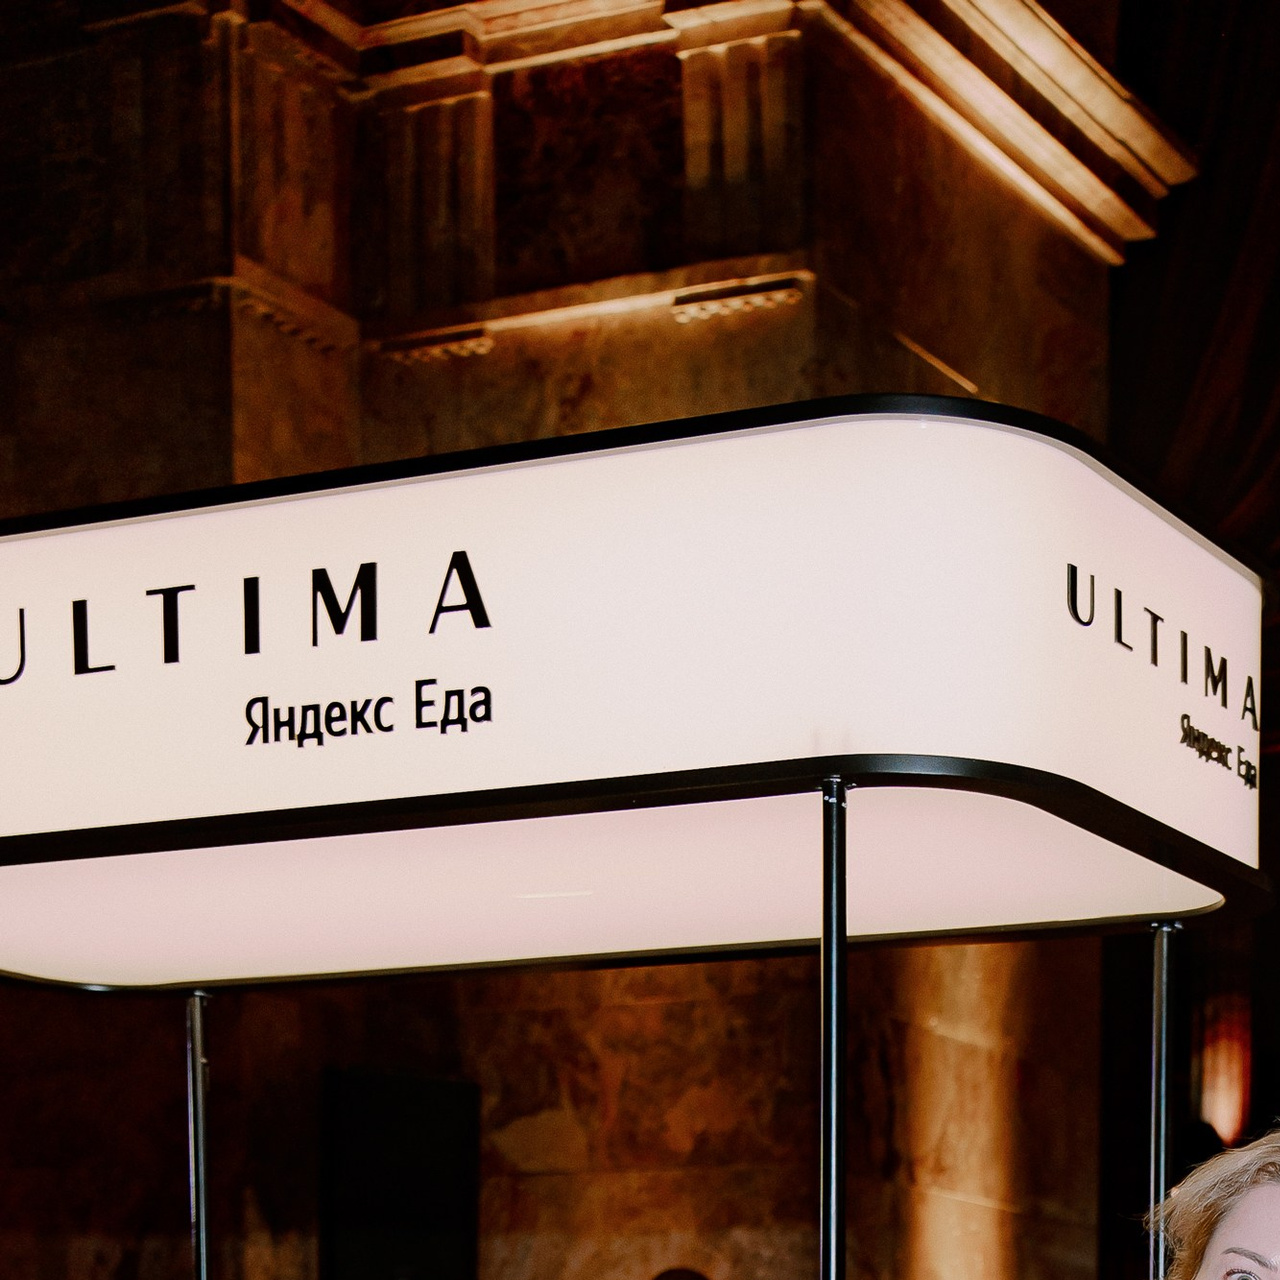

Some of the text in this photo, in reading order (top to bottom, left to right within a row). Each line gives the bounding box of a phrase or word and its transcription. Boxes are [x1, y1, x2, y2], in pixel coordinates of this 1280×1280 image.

[1067, 563, 1259, 732] ULTIMA
[245, 678, 493, 748] Яндекс Еда
